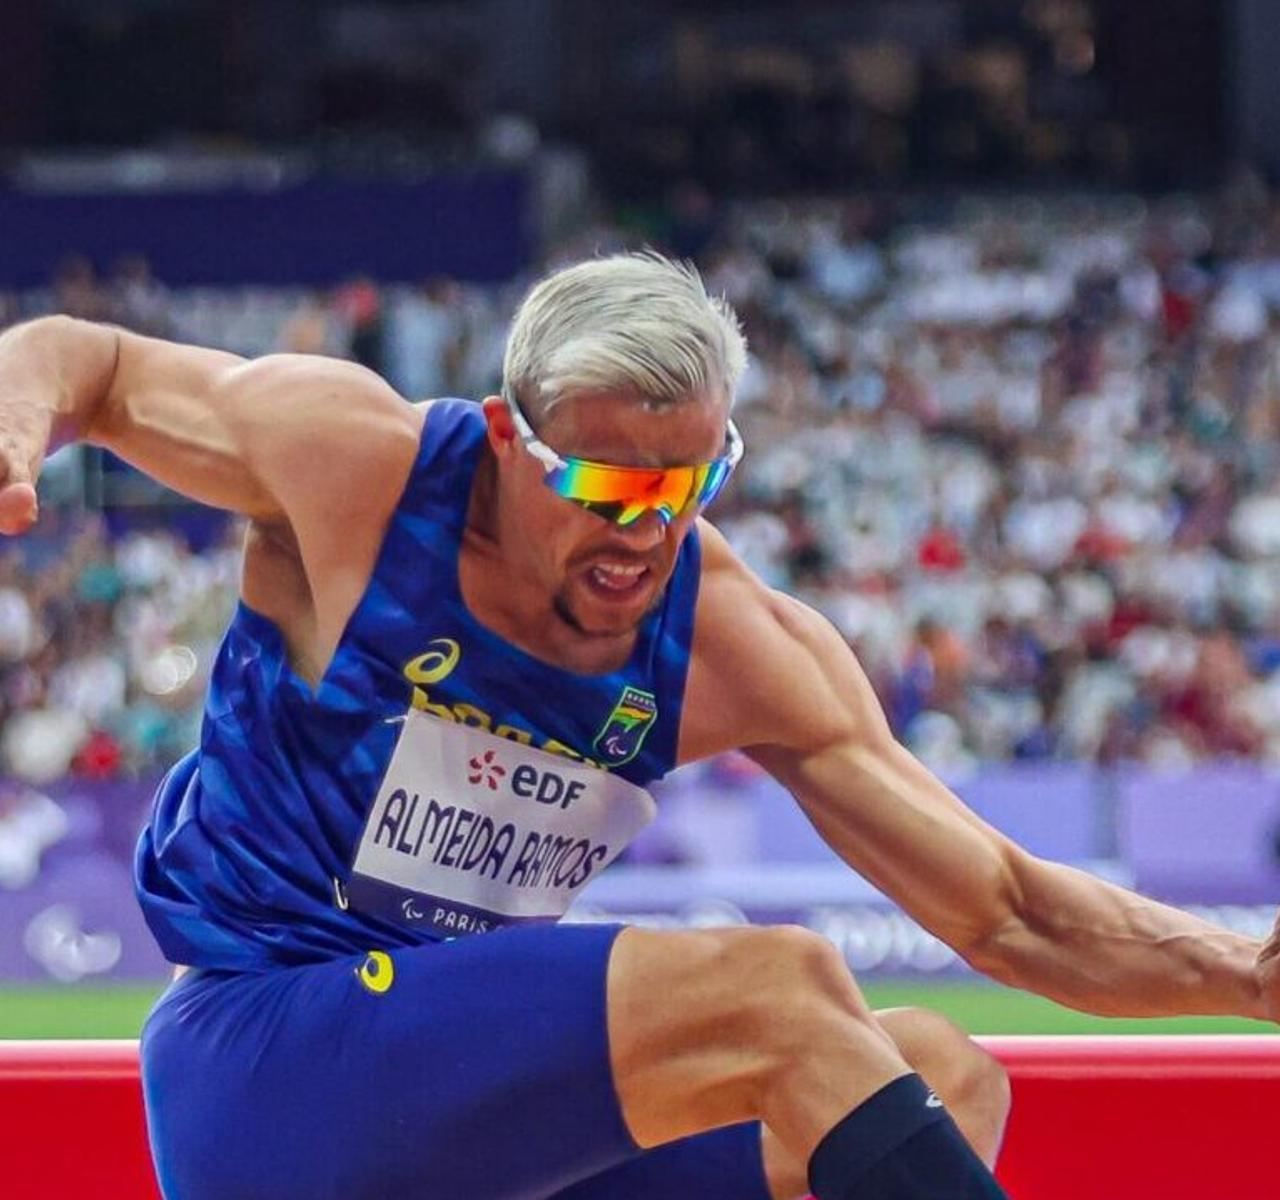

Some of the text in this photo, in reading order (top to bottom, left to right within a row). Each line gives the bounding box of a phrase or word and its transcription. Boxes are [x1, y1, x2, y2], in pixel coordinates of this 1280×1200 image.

[373, 788, 608, 889] ALMEIDA RAMOS
[433, 908, 489, 935] PARIS
